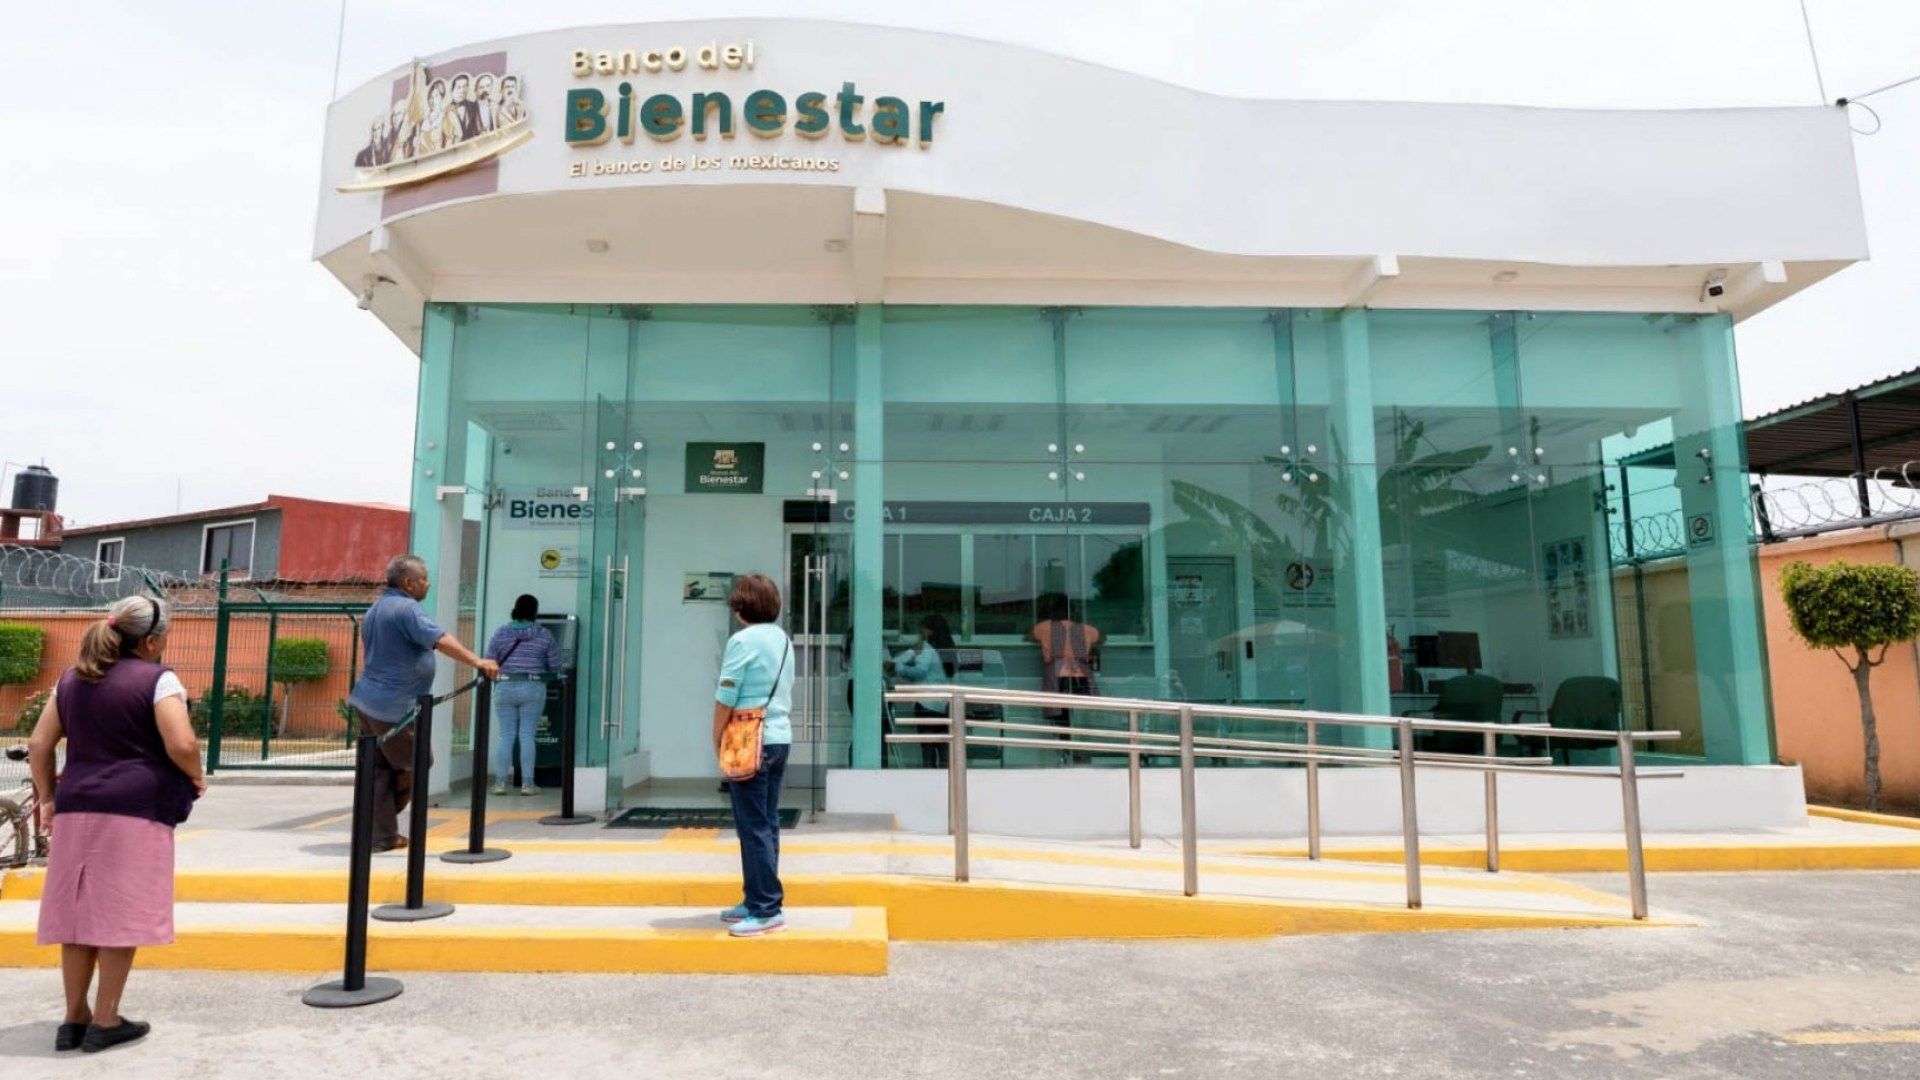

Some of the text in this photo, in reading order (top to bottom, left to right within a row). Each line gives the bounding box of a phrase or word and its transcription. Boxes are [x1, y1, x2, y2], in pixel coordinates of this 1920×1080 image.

[573, 39, 754, 77] Banco del
[565, 81, 944, 148] Bienestar
[570, 152, 840, 177] El banco de los mexicanos
[699, 474, 748, 485] Bienestar
[843, 506, 907, 520] CA 1
[1028, 507, 1093, 522] CAJA 2
